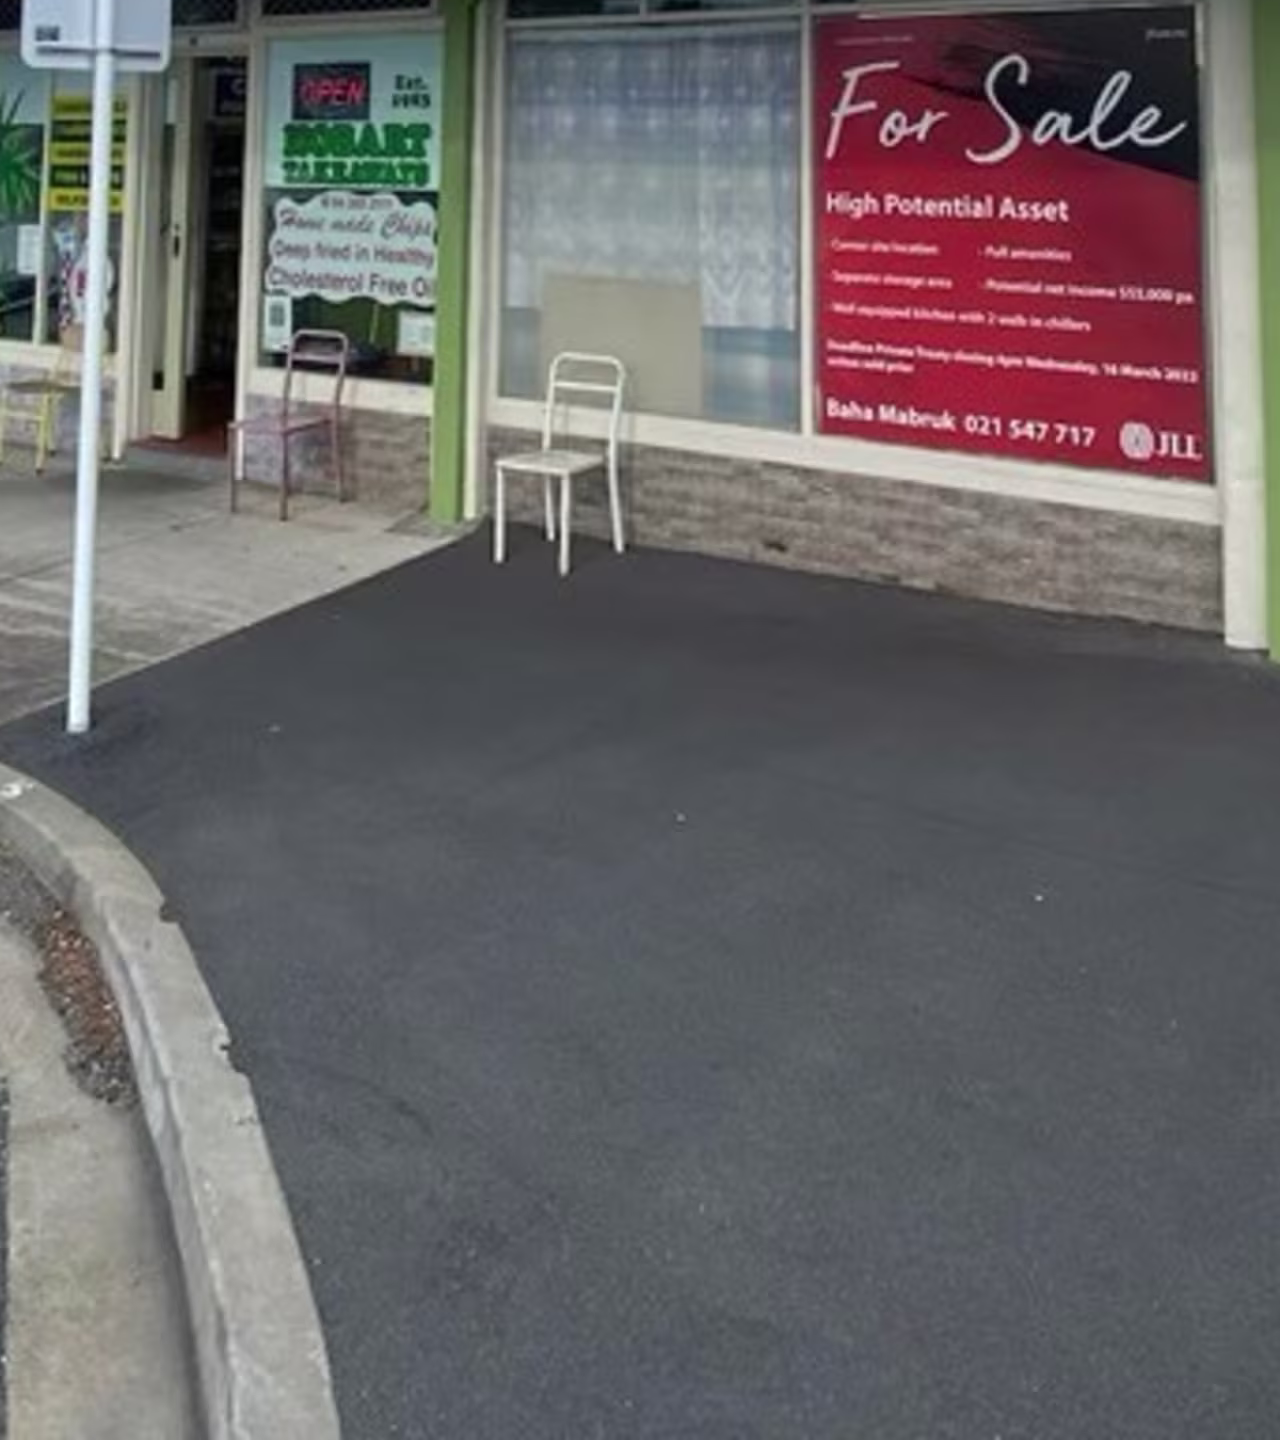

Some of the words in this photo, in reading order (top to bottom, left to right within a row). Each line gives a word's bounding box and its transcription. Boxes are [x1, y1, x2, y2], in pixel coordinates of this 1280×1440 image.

[299, 78, 363, 104] OPEN
[826, 62, 949, 159] For
[965, 54, 1187, 164] Sale
[283, 123, 432, 158] HOBART
[826, 191, 880, 219] High
[883, 193, 994, 219] Potential
[999, 196, 1069, 222] Asset
[272, 239, 310, 261] Deep
[317, 242, 350, 259] fried
[355, 244, 369, 258] in
[373, 246, 434, 270] Healthy
[831, 237, 867, 253] Corner
[984, 244, 1008, 258] Full
[1010, 247, 1073, 262] amenities
[271, 266, 363, 292] Cholesterol
[370, 273, 408, 296] Free
[831, 269, 881, 285] Separate
[883, 274, 924, 289] storage
[984, 278, 1042, 295] Potential
[1044, 283, 1065, 296] net
[1067, 284, 1117, 299] income
[1175, 290, 1195, 305] pa
[857, 305, 910, 320] equipped
[913, 307, 956, 321] kitchen
[958, 311, 985, 323] with
[1044, 317, 1092, 333] chillers
[1120, 364, 1162, 381] March
[826, 397, 874, 421] Baha
[879, 404, 957, 430] Mabruk
[964, 414, 1002, 436] 021
[1008, 418, 1049, 442] 547
[1053, 422, 1096, 447] 717
[1156, 430, 1203, 459] JLL
